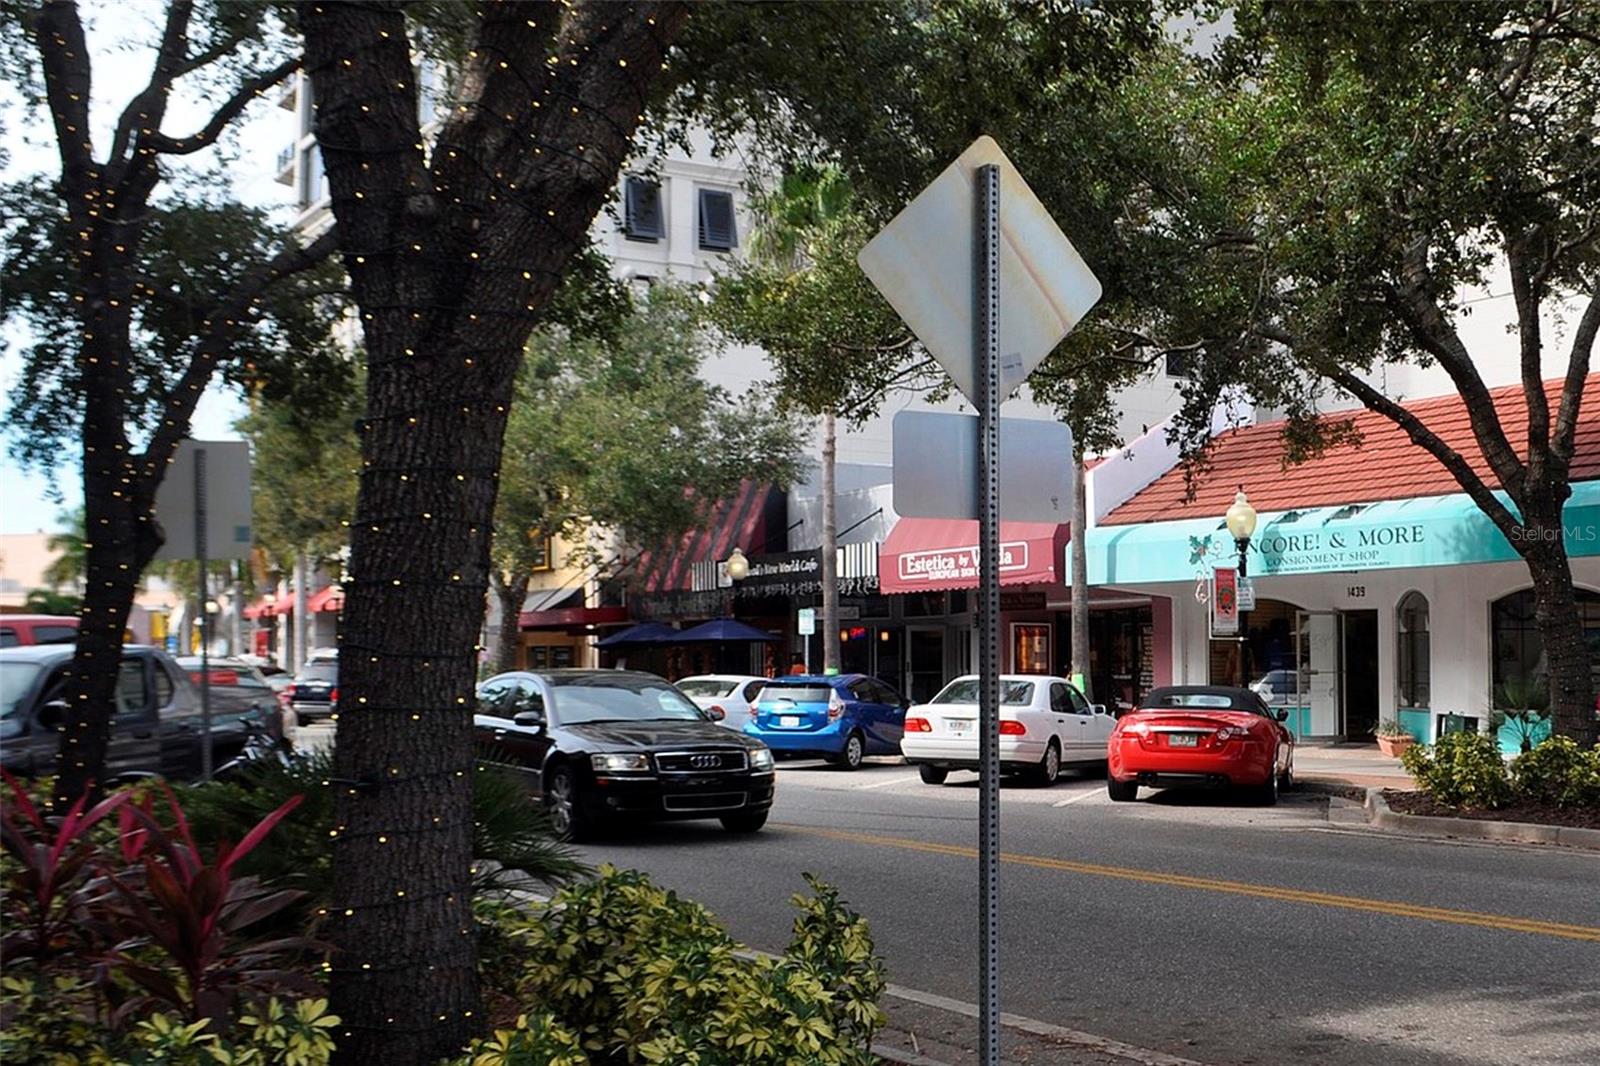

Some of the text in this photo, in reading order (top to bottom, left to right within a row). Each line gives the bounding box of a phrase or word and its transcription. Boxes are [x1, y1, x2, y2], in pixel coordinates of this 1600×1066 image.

[1235, 525, 1425, 555] NCORE! & MORE
[906, 554, 955, 574] Estetica
[958, 554, 970, 567] by
[1266, 550, 1379, 568] CONSIGNMENT SHOP
[1347, 586, 1366, 598] 1439
